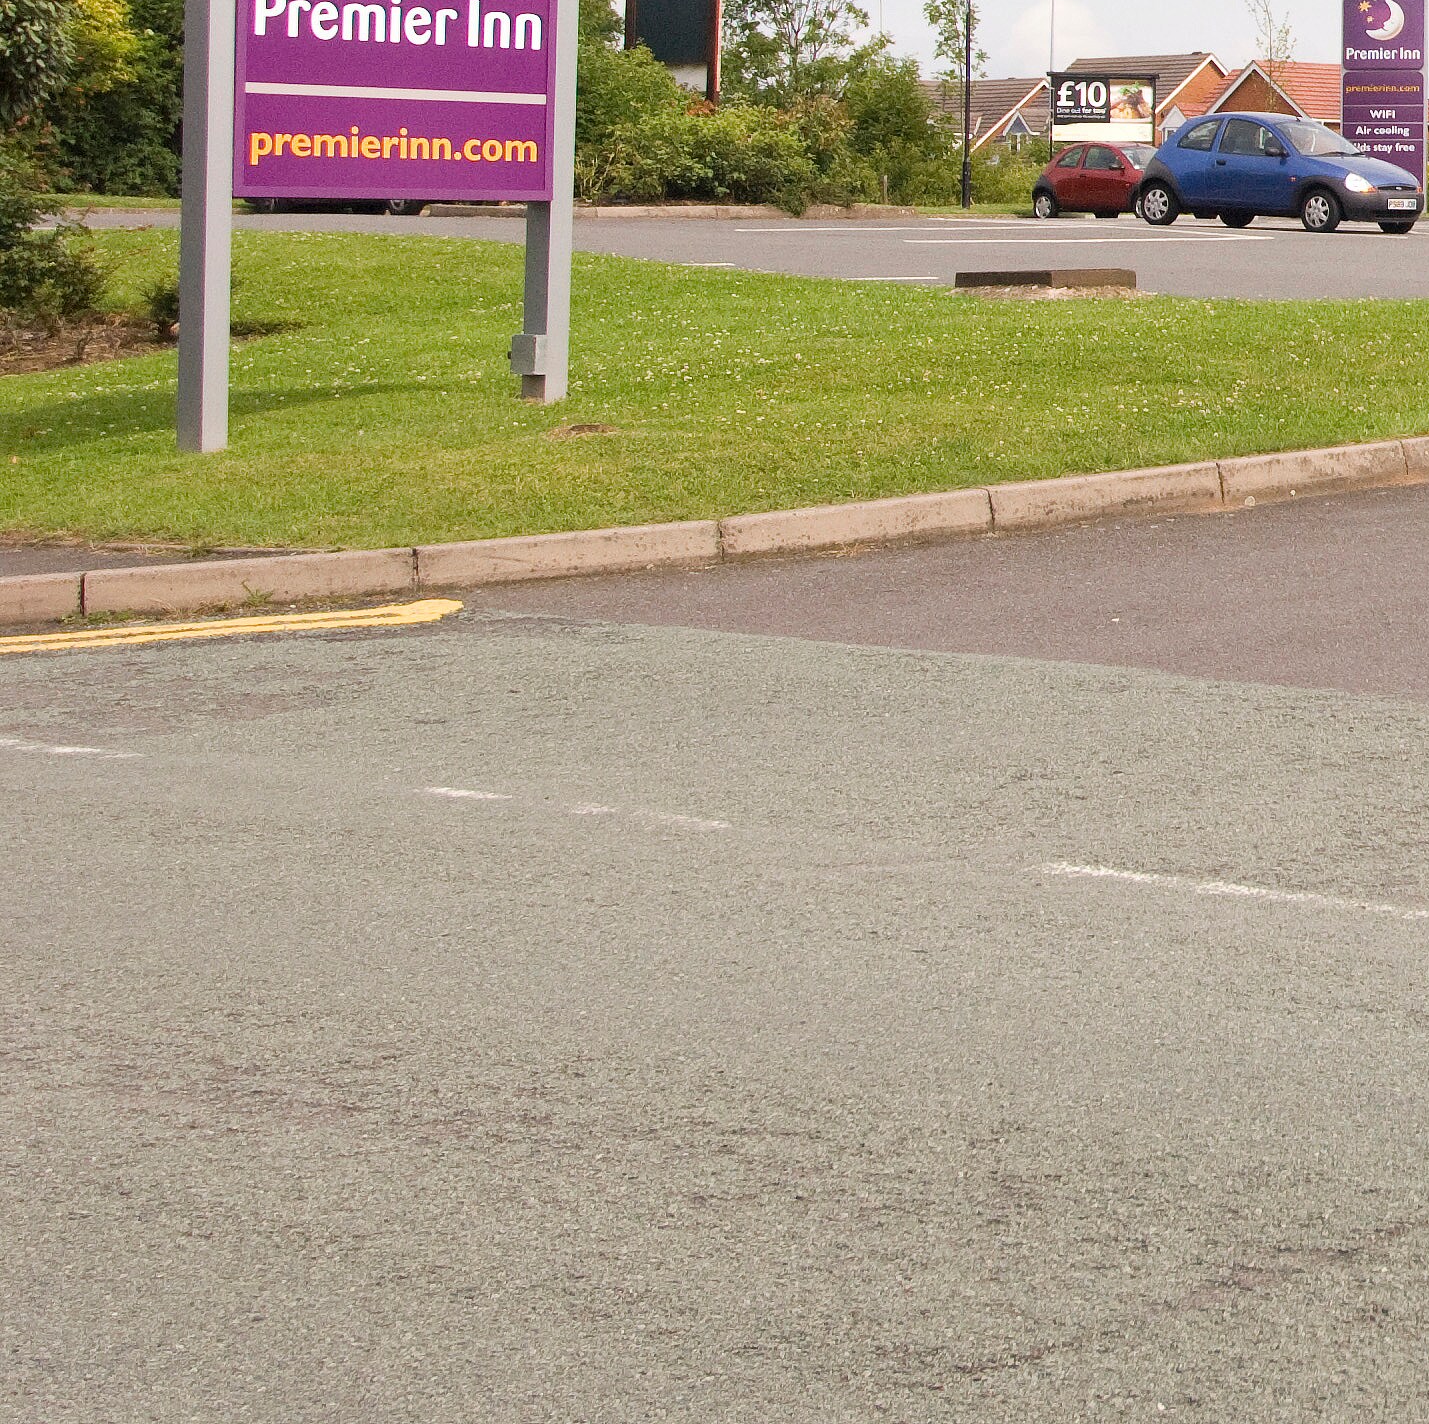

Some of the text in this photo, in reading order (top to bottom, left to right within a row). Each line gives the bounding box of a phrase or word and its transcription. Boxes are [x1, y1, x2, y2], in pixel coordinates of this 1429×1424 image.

[1345, 46, 1421, 60] Premier Inn
[1056, 80, 1107, 108] £10
[1355, 125, 1410, 137] Air cooling
[249, 125, 538, 166] premierinn.com
[1373, 143, 1393, 154] stay
[1394, 142, 1416, 152] free
